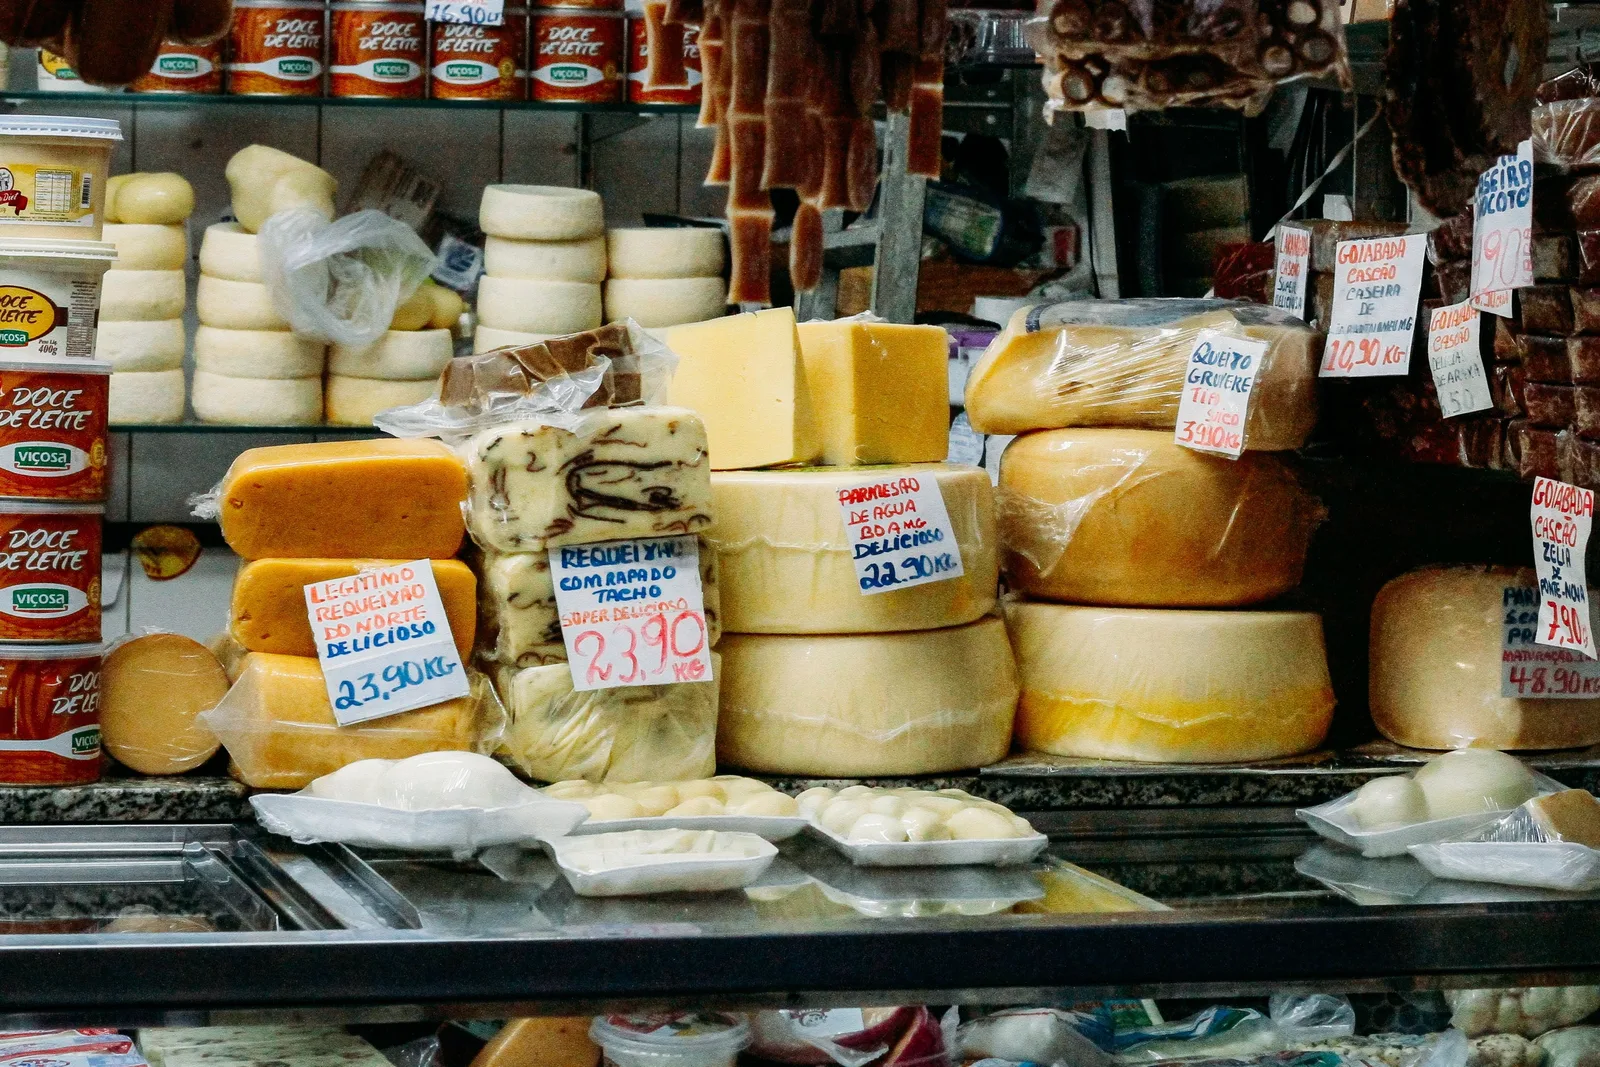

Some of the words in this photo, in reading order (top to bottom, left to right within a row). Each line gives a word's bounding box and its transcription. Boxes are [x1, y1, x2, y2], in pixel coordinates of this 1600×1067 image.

[275, 19, 318, 33] DOCE
[371, 22, 416, 36] DOCE
[549, 27, 595, 40] DOCE
[359, 37, 384, 50] DE
[382, 37, 420, 50] LEITE
[453, 39, 500, 53] LEITE
[560, 42, 604, 56] LEITE
[1338, 238, 1407, 265] GOIABADA
[1347, 262, 1397, 284] CASCÃO
[0, 294, 33, 309] OCE
[1346, 283, 1401, 301] CASEIRA
[1357, 302, 1375, 316] DE
[38, 345, 58, 356] 400g
[12, 387, 83, 408] DOCE
[0, 409, 31, 428] DE
[28, 409, 93, 430] LEITE
[1533, 479, 1593, 518] GOIABADA
[847, 509, 869, 526] DE
[903, 517, 927, 530] MG
[9, 528, 79, 549] DOCE
[1535, 515, 1578, 548] CASCÃO
[853, 527, 944, 560] DELICIOSO
[0, 551, 28, 570] DE
[25, 551, 88, 571] LEITE
[560, 573, 602, 591] COM
[605, 568, 648, 587] RAPA
[650, 565, 677, 581] DO
[592, 585, 662, 603] TACHO
[324, 622, 351, 641] DO
[356, 604, 427, 634] NORTE
[561, 608, 610, 628] SUPER
[613, 597, 689, 621] DELICIOSO
[326, 620, 436, 659] DELICIOSO
[671, 658, 706, 682] KG
[69, 671, 101, 693] DOC
[52, 694, 84, 714] DE
